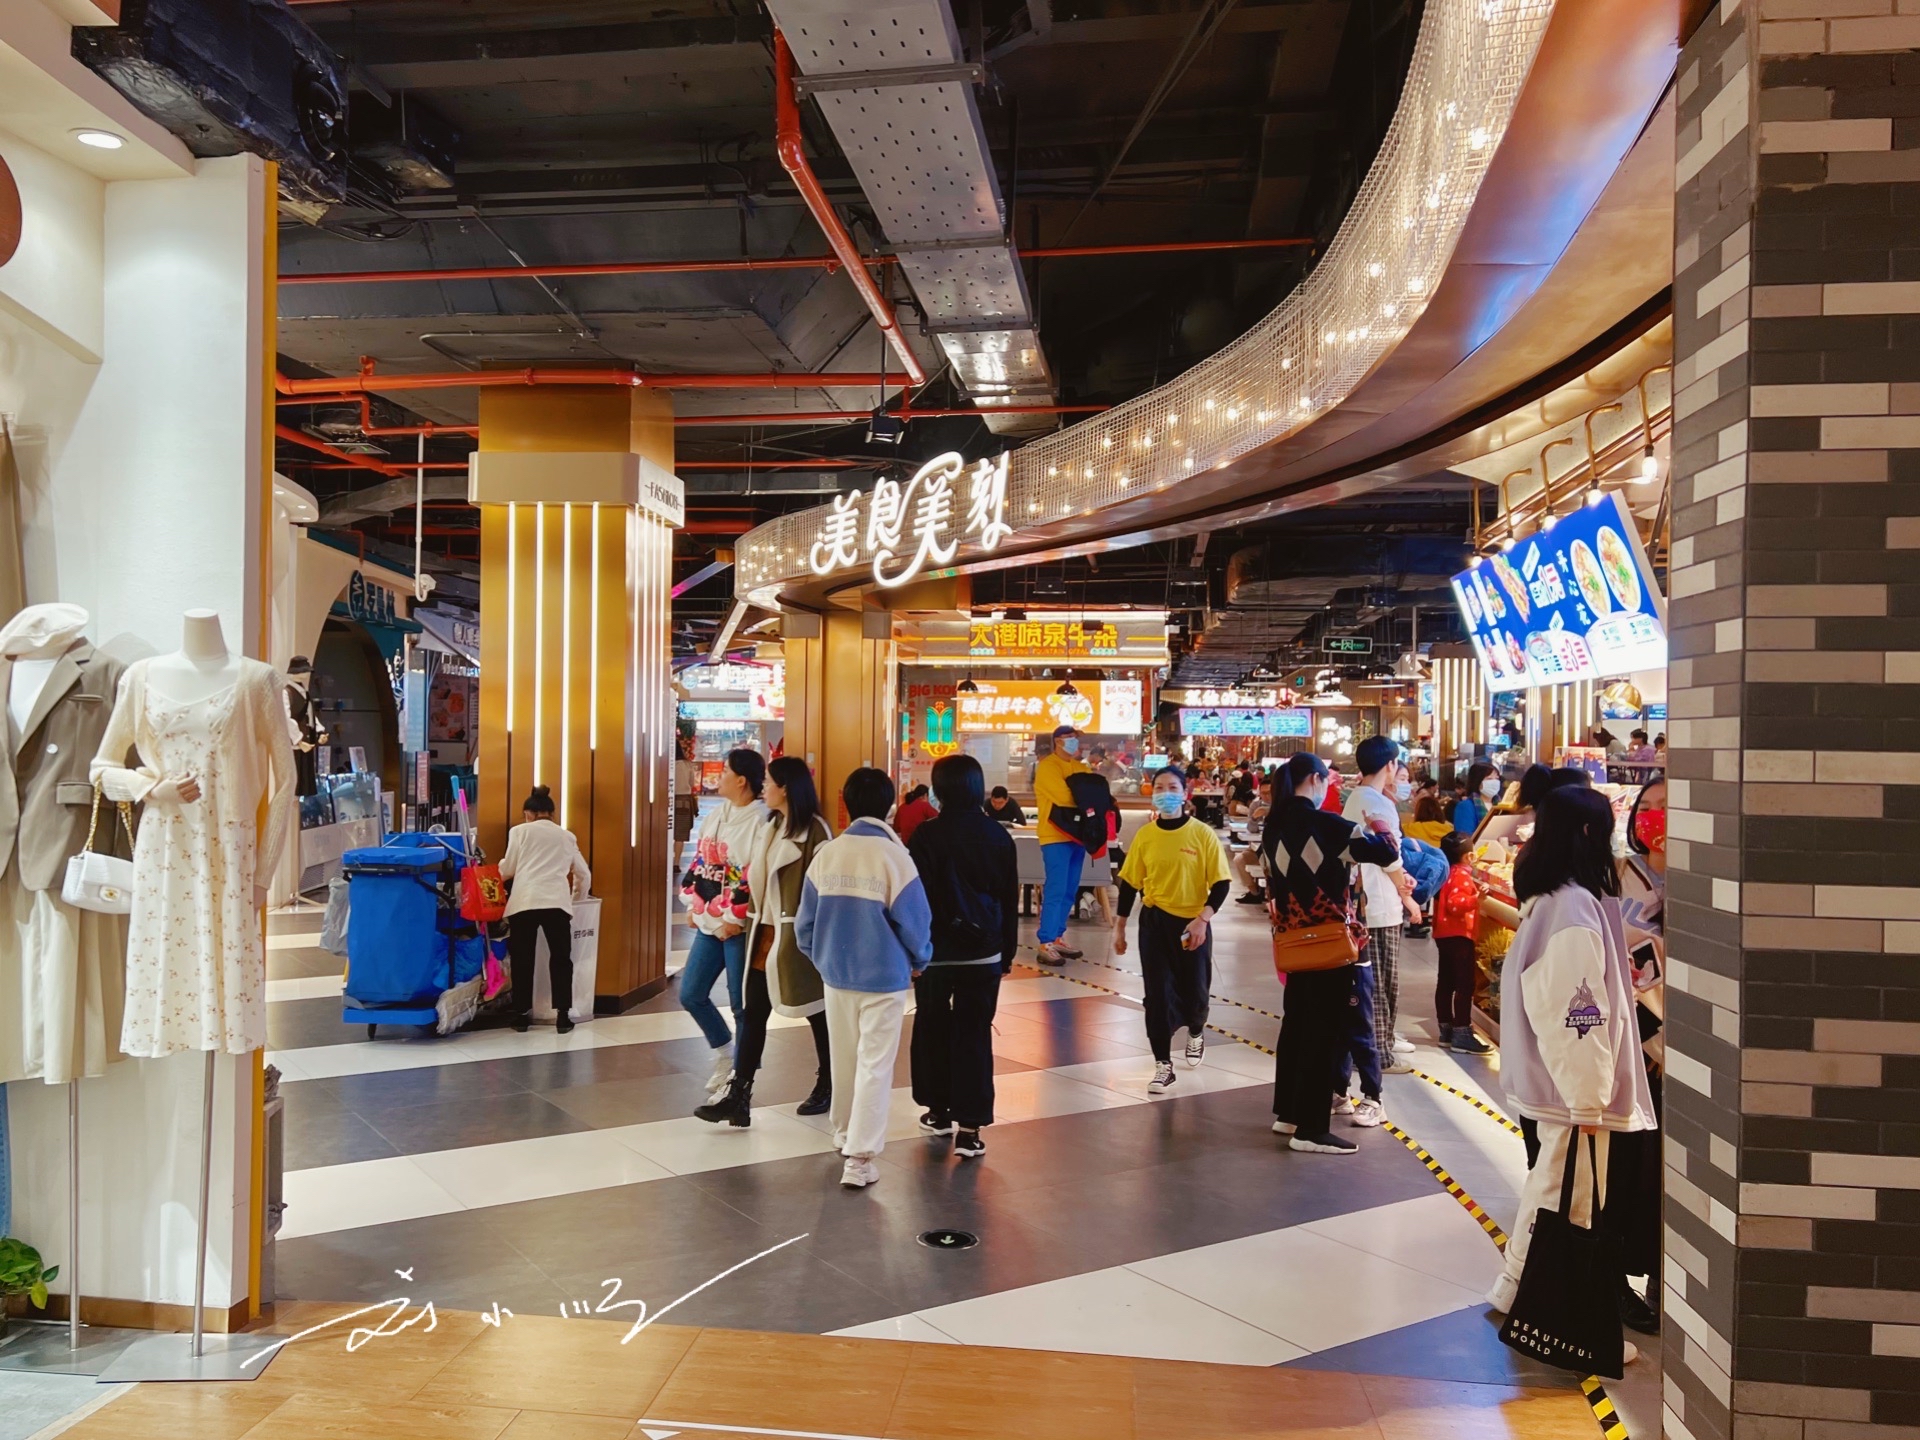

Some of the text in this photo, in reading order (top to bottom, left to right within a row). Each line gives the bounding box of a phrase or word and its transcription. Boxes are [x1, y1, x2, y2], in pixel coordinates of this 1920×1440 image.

[650, 481, 678, 510] FASHION
[809, 450, 1013, 587] 美食美刻
[908, 684, 930, 698] BIG
[1105, 685, 1137, 695] BIG KONG
[1510, 1330, 1551, 1355] WORLD
[1513, 1319, 1593, 1359] BEAUTIFUL
